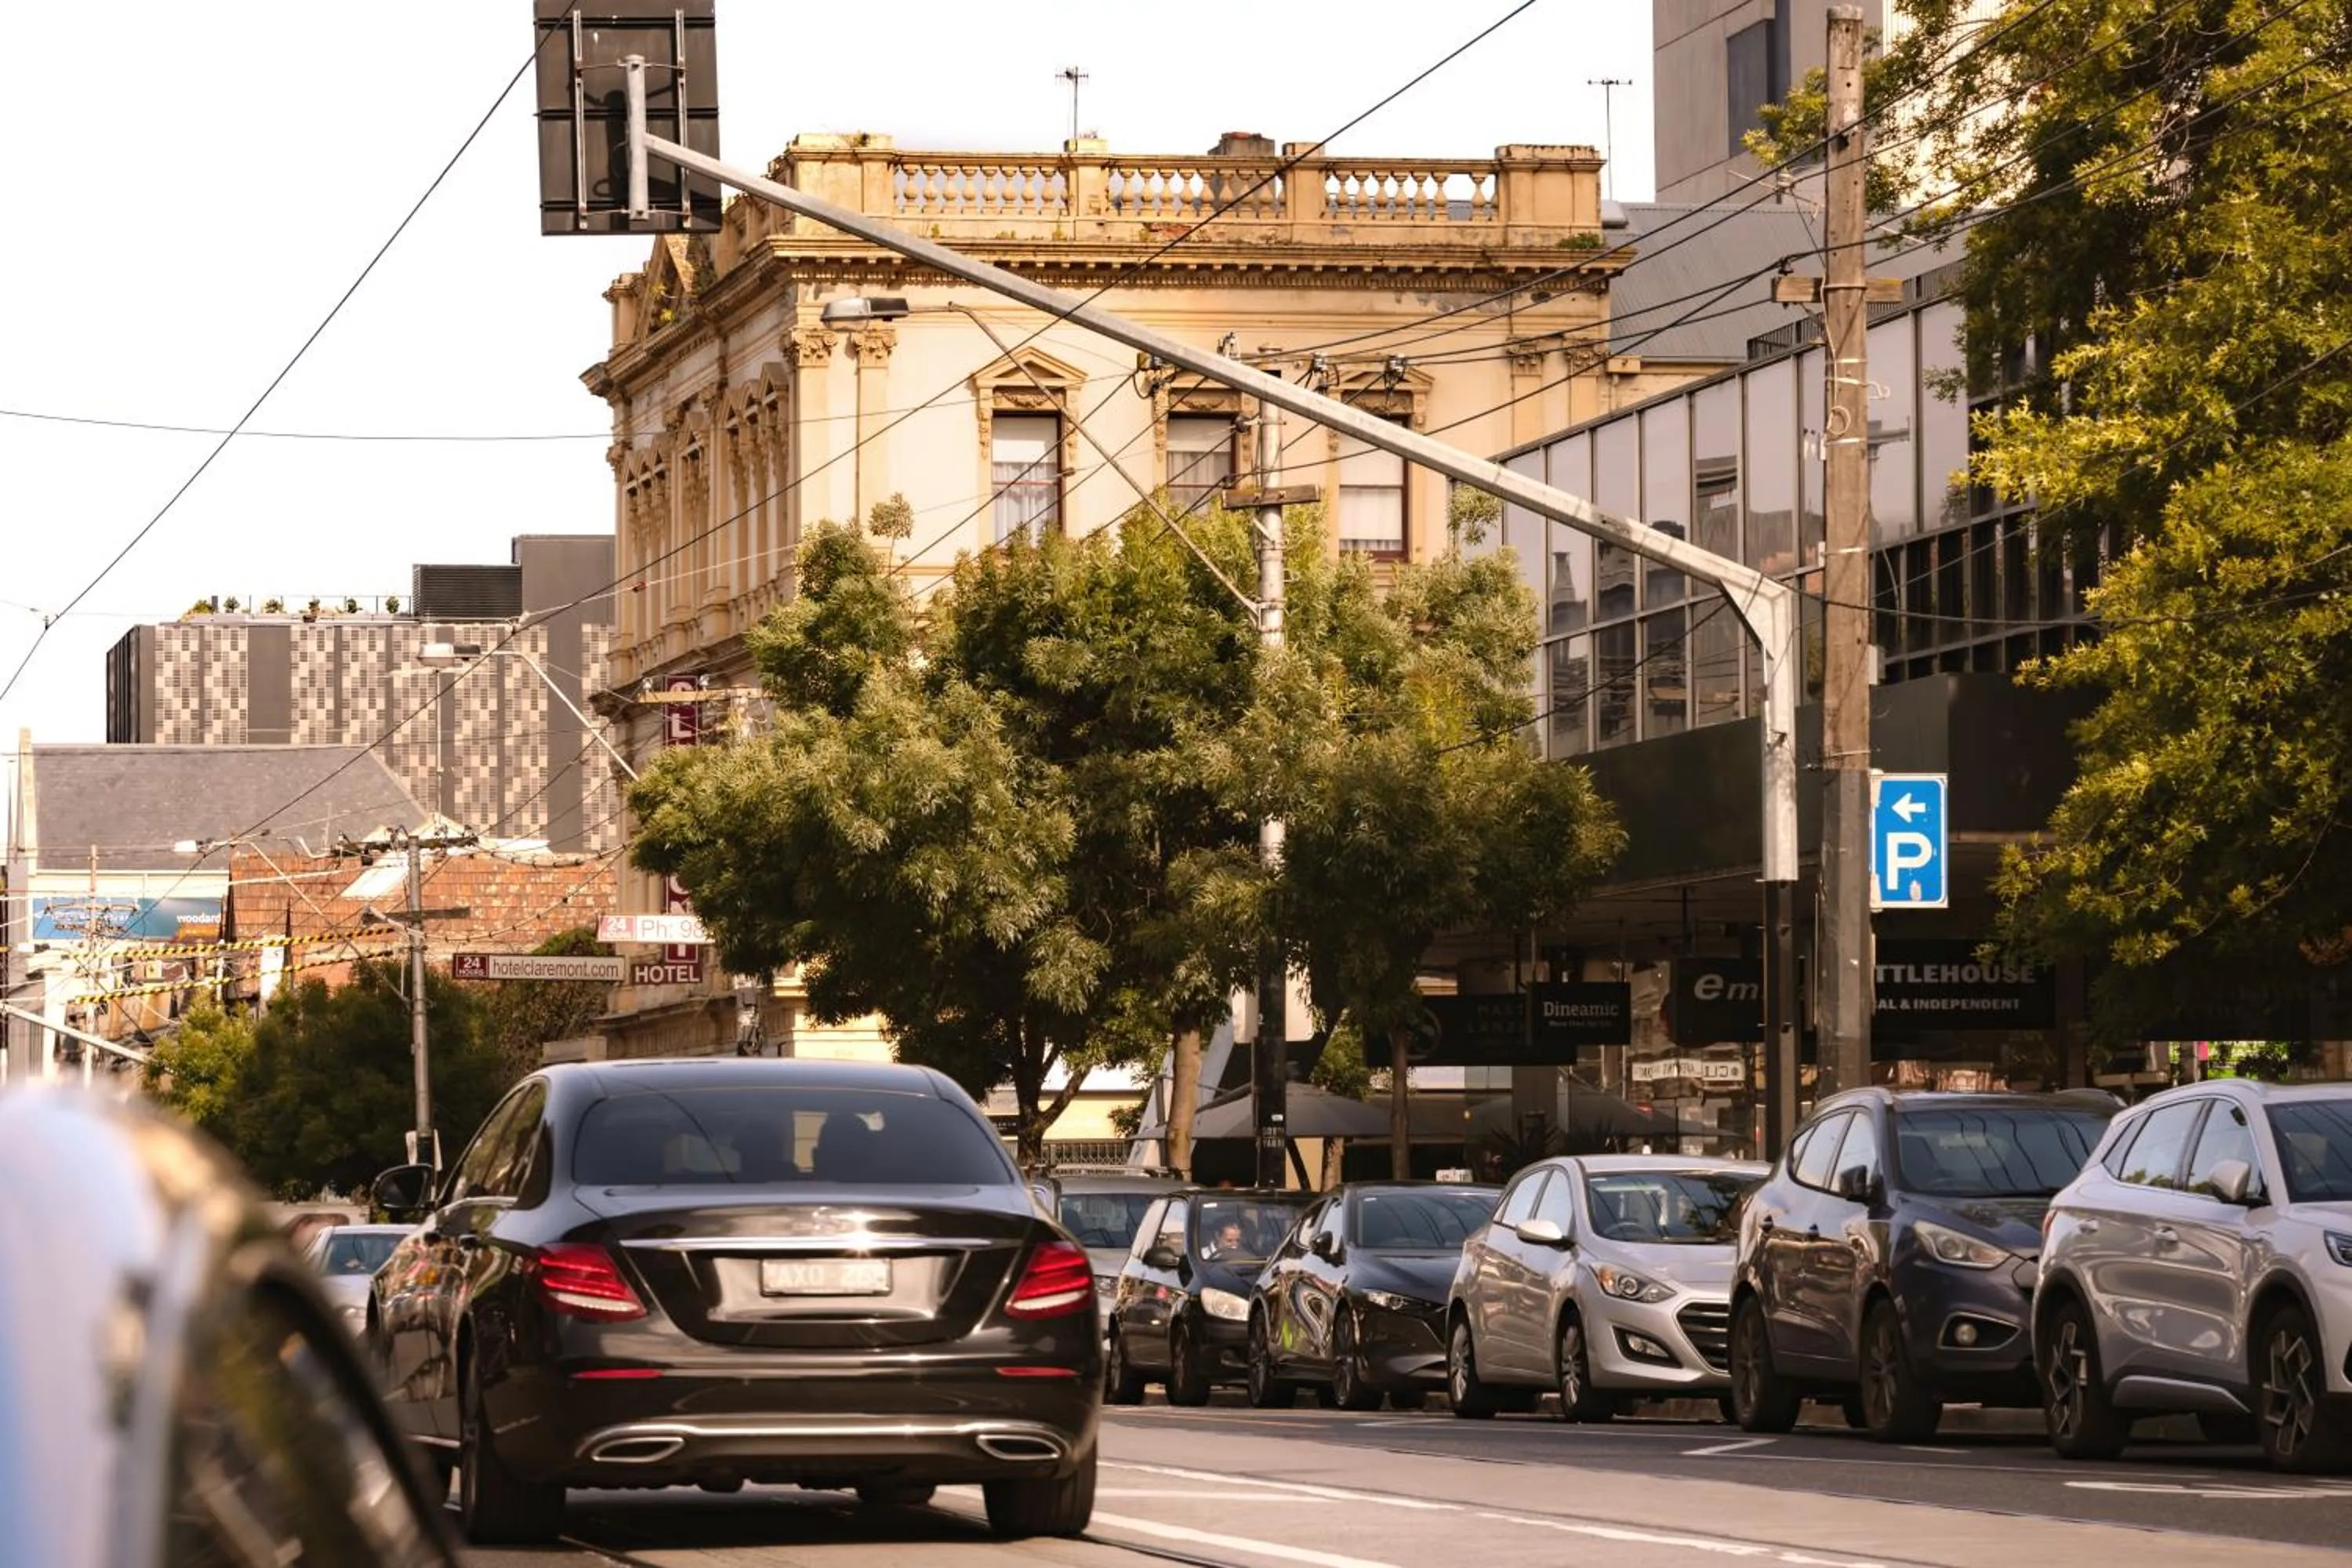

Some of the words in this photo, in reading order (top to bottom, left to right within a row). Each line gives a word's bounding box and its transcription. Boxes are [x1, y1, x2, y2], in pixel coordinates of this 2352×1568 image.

[1886, 832, 1933, 891] P
[176, 912, 221, 923] woodard
[606, 918, 626, 931] 24
[641, 920, 673, 938] Ph:
[463, 957, 481, 968] 24
[493, 959, 619, 978] hotelclaremont.com
[634, 965, 700, 983] HOTEL
[1875, 964, 2037, 984] TTLEHOUSE
[1693, 973, 1760, 1000] em
[1542, 1000, 1620, 1017] Dineamic
[1875, 998, 1898, 1010] AL
[1900, 998, 1911, 1010] &
[1913, 998, 2020, 1011] INDEPENDENT
